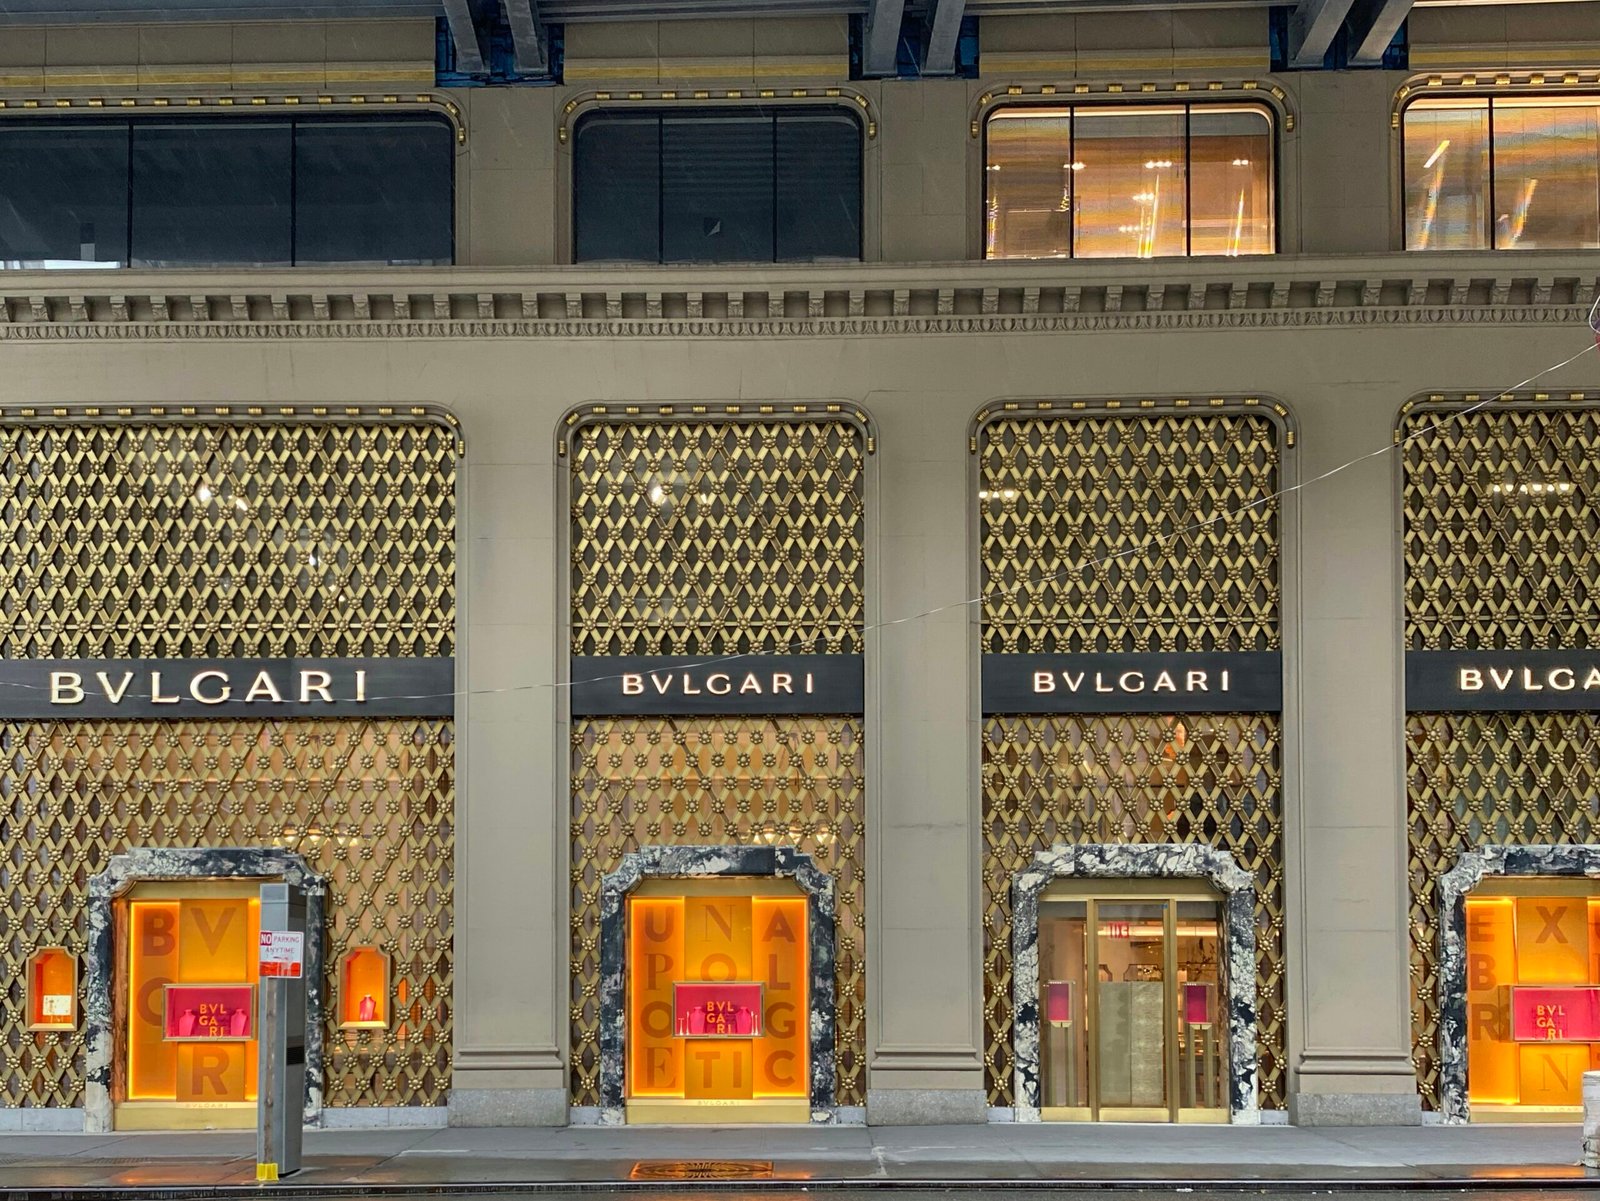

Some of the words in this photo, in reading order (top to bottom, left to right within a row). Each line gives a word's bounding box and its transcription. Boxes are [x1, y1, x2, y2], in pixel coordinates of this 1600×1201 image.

[50, 670, 367, 705] BVLGARI
[621, 672, 814, 696] BVLGARI
[1033, 670, 1230, 693] BVLGARI
[261, 933, 272, 945] NO
[273, 935, 300, 944] PARKING
[265, 946, 295, 954] ANYTIME
